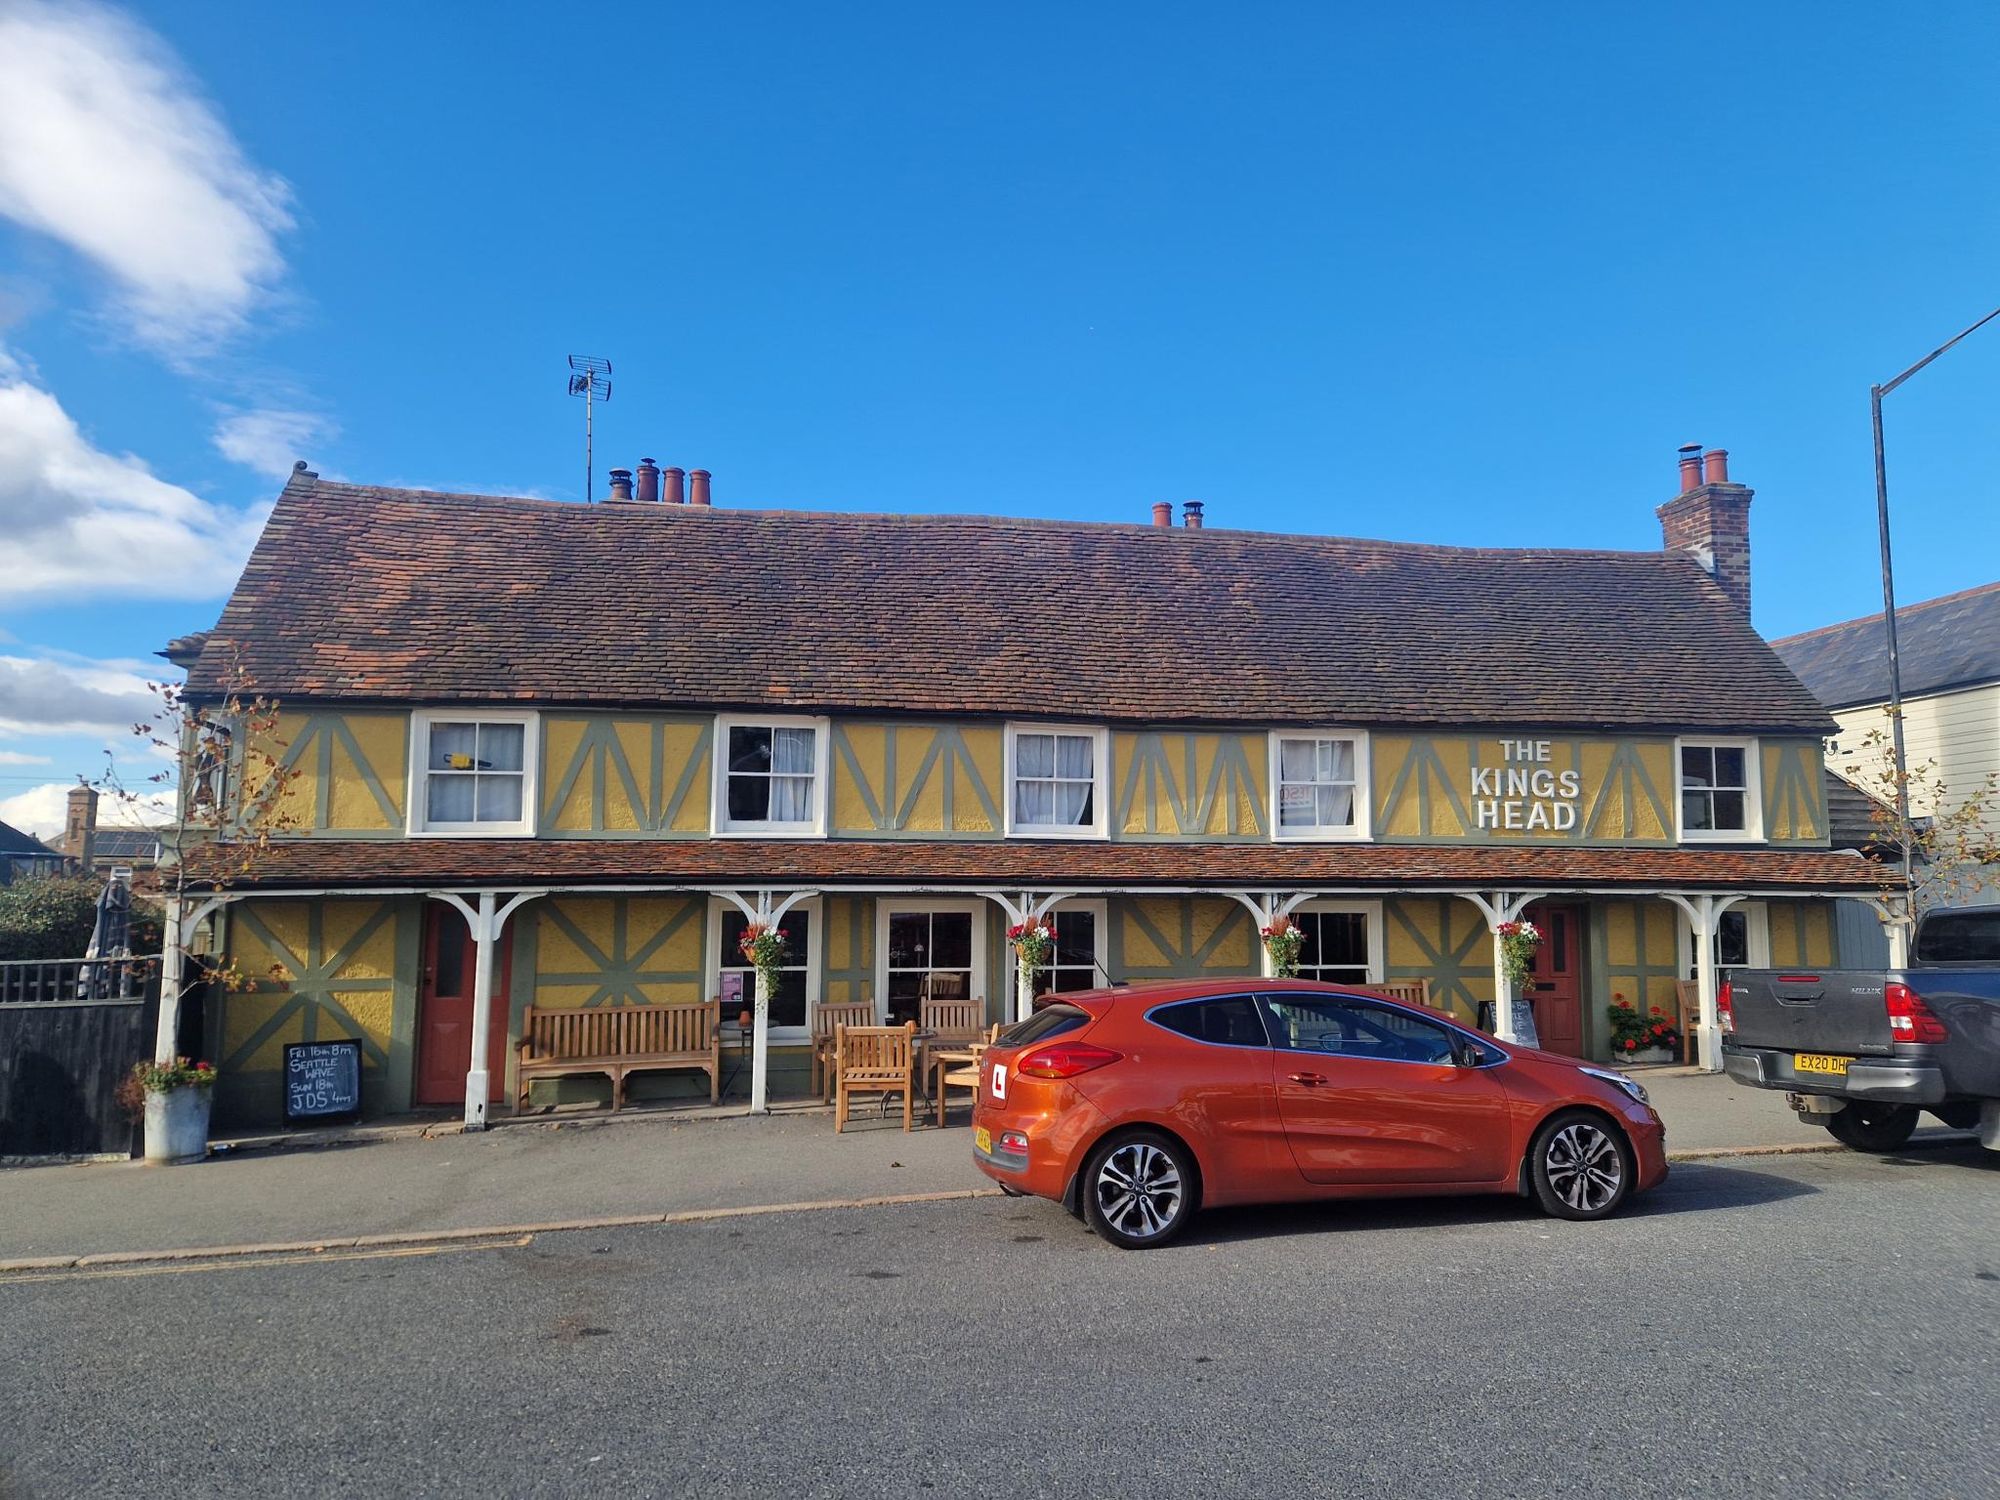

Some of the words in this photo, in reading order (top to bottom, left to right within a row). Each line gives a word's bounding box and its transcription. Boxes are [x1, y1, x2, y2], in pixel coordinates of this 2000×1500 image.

[1499, 739, 1552, 761] THE
[1471, 767, 1579, 798] KINGS
[1478, 800, 1576, 830] HEAD
[290, 1047, 306, 1058] FRI
[290, 1058, 338, 1073] SEATTLE
[1801, 1055, 1829, 1069] EX20
[1832, 1058, 1847, 1071] DH
[305, 1067, 336, 1079] WAVE
[995, 1071, 1002, 1091] L
[290, 1082, 313, 1093] SUN
